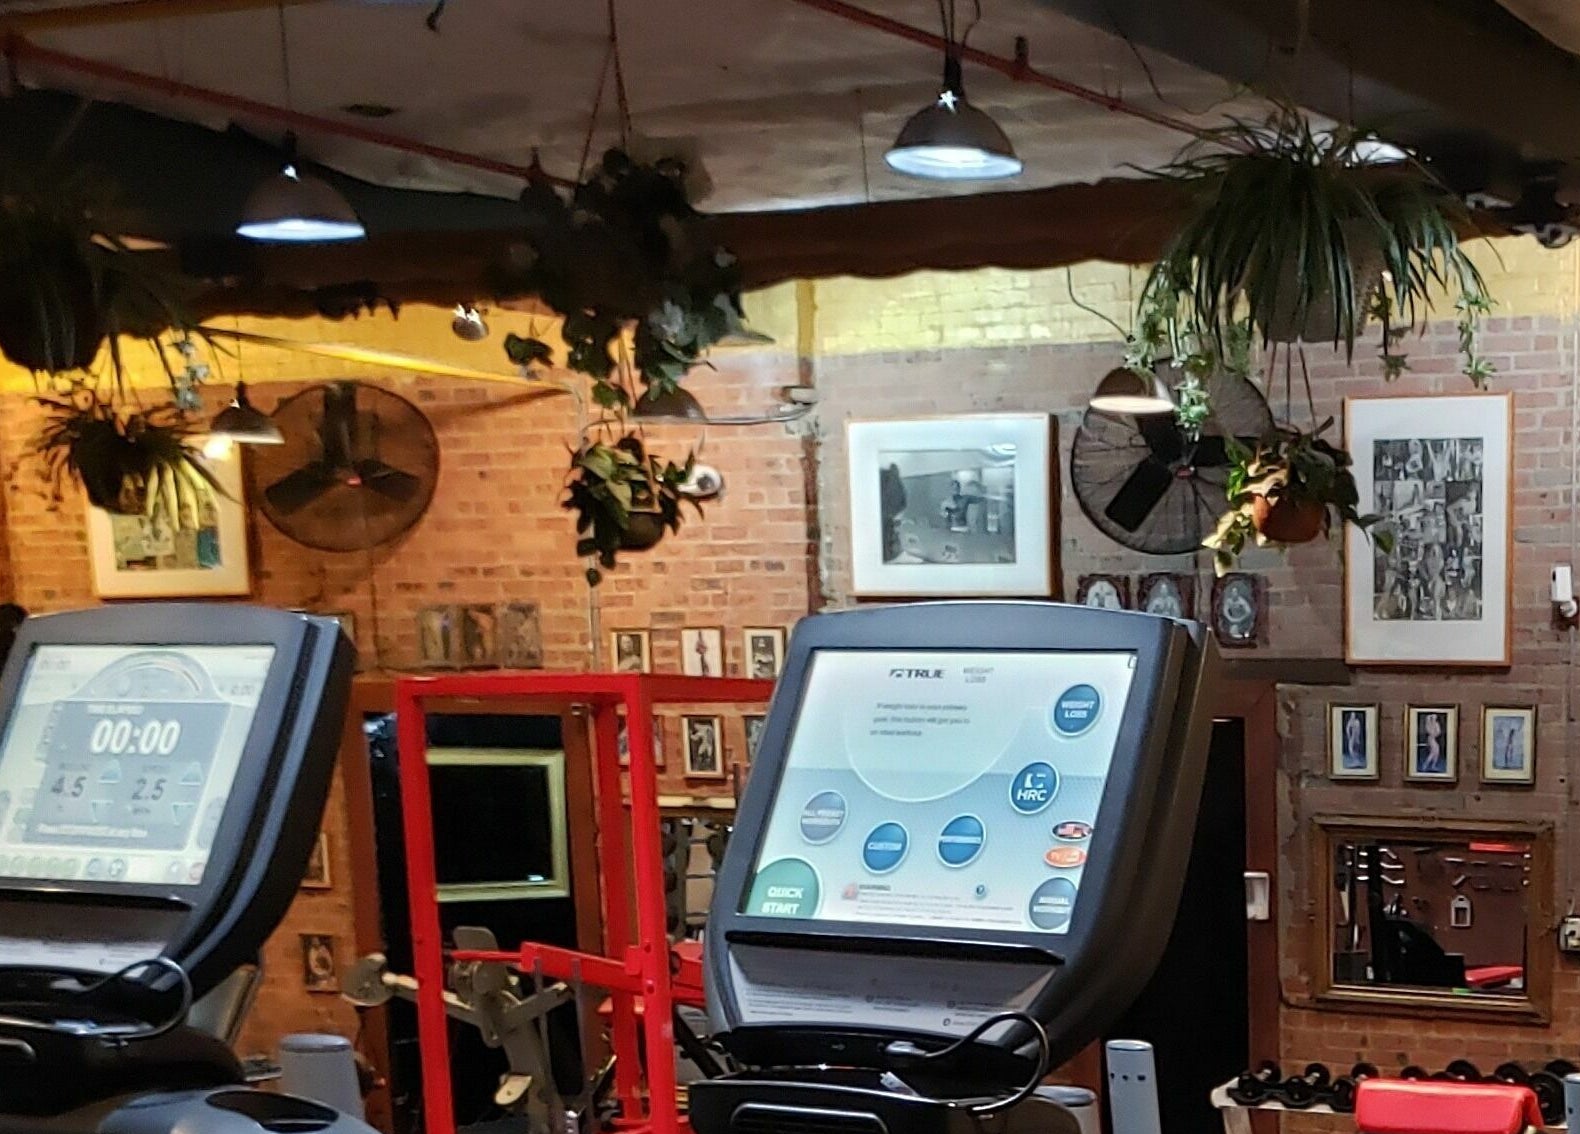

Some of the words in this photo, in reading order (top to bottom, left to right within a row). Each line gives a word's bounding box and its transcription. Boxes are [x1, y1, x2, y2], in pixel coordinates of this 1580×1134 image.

[906, 669, 946, 679] TRUE
[90, 718, 181, 755] 00:00
[1017, 789, 1047, 801] HRC
[767, 886, 804, 899] QUICK
[761, 902, 800, 915] START
